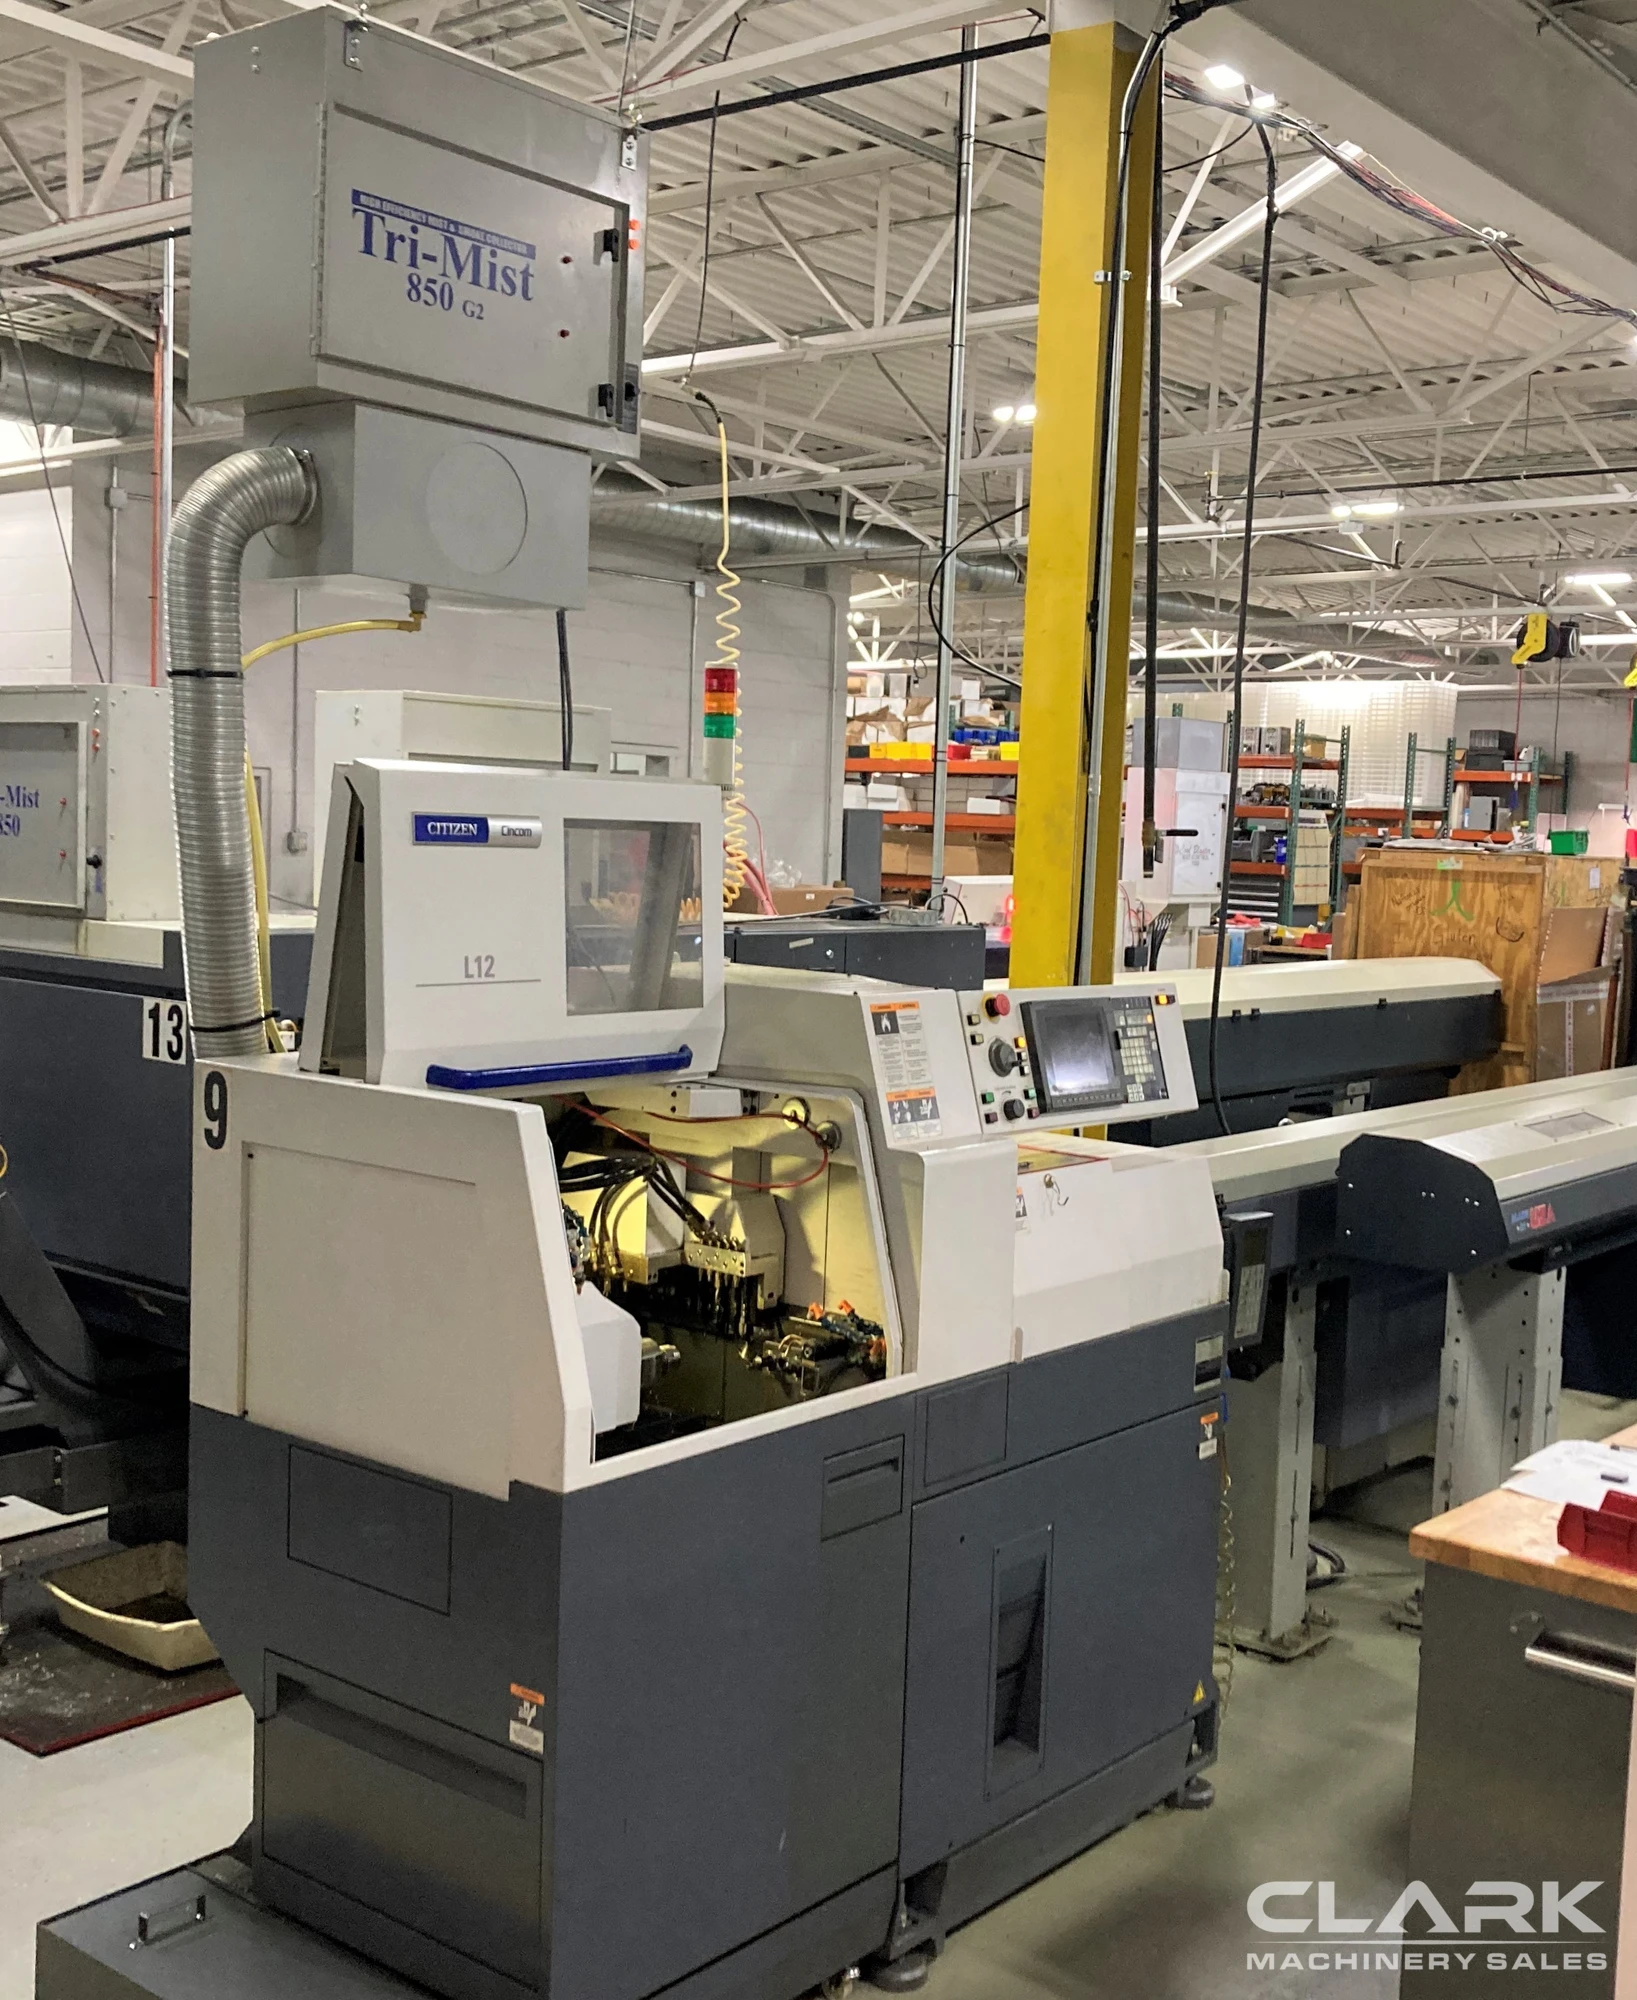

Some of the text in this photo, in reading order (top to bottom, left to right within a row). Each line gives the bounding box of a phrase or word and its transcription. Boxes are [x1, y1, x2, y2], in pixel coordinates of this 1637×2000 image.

[352, 207, 535, 301] Tri-Mist
[407, 272, 485, 320] 850 G2
[427, 821, 532, 837] CITIZEN Cincom
[464, 955, 495, 978] L12
[148, 1002, 183, 1061] 13
[204, 1070, 228, 1150] 9
